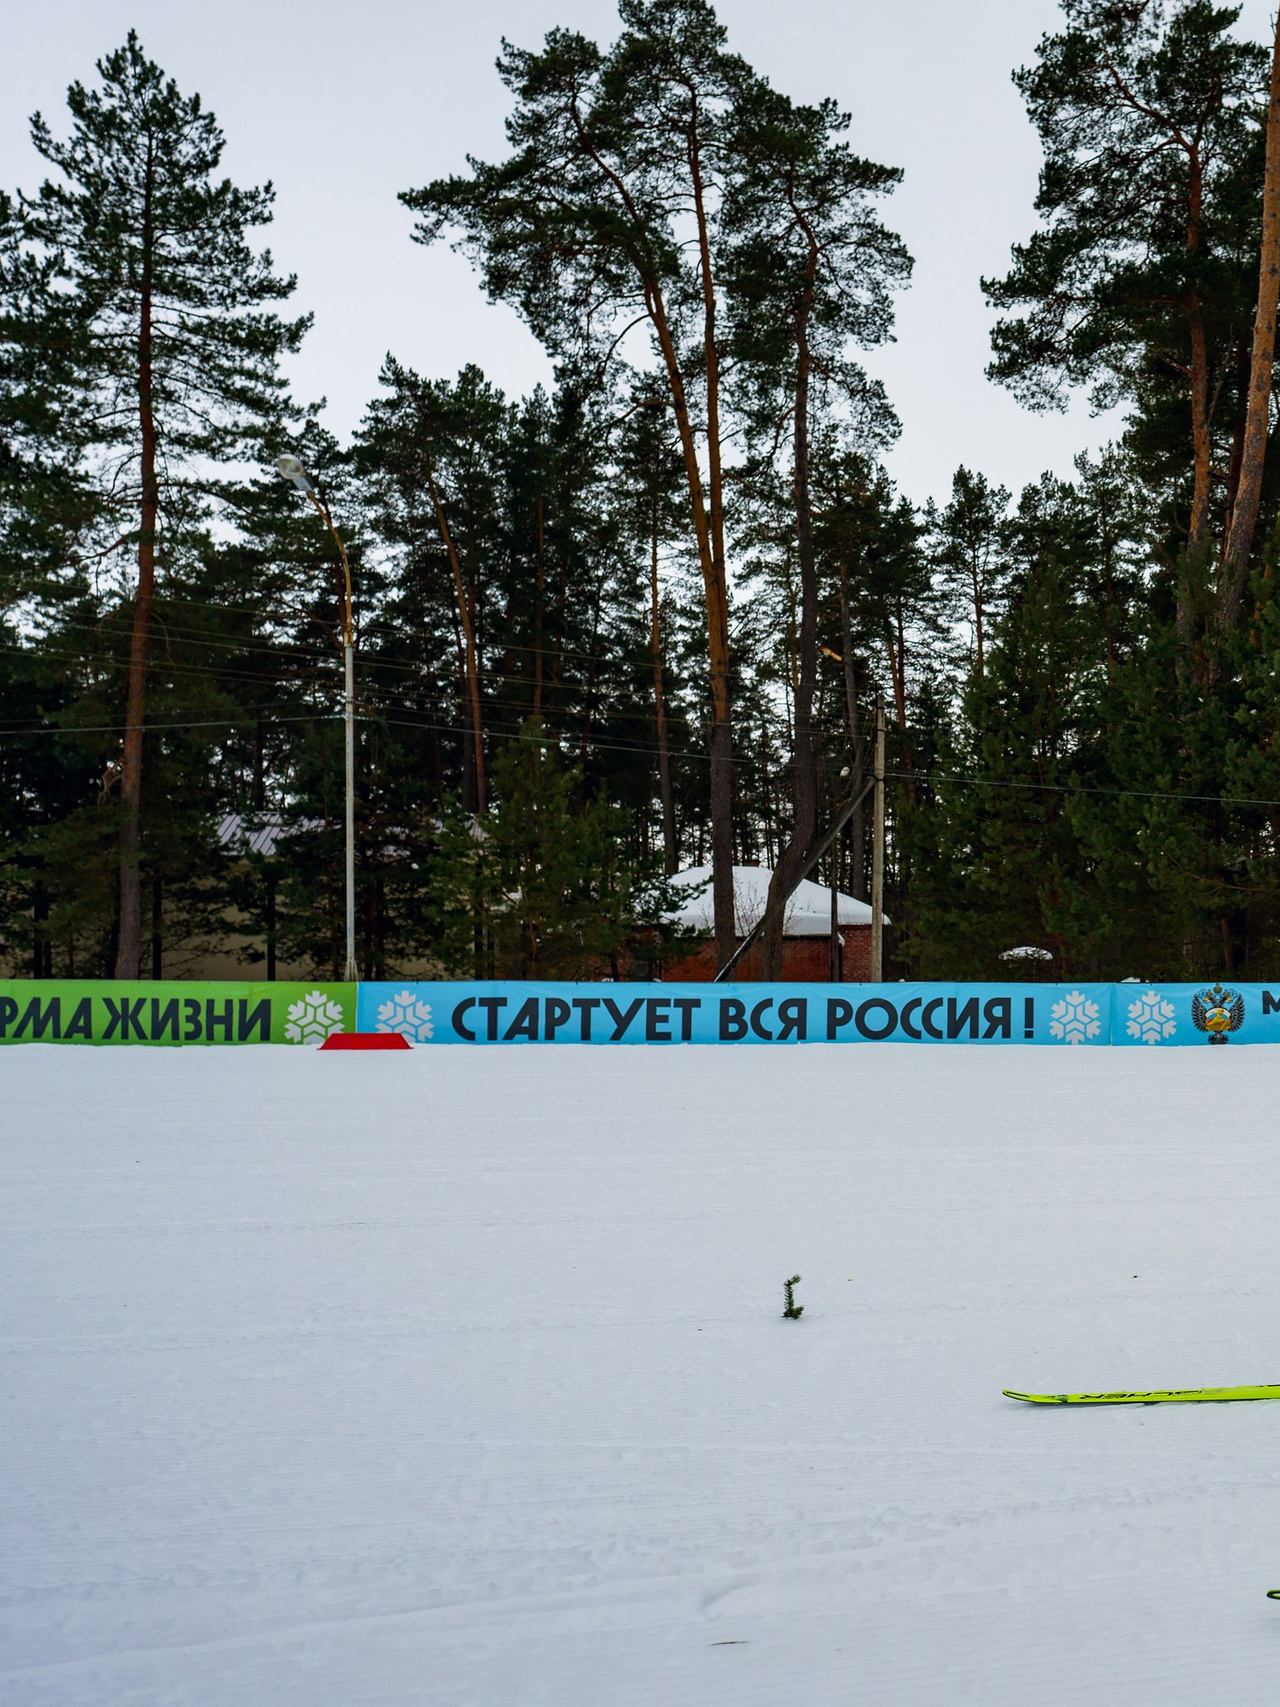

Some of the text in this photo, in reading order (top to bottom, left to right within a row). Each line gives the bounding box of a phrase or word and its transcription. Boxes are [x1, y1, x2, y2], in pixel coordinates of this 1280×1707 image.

[102, 997, 271, 1042] ЖИЗНИ
[451, 997, 701, 1041] СТАРТУЕТ
[719, 997, 807, 1040] ВСЯ
